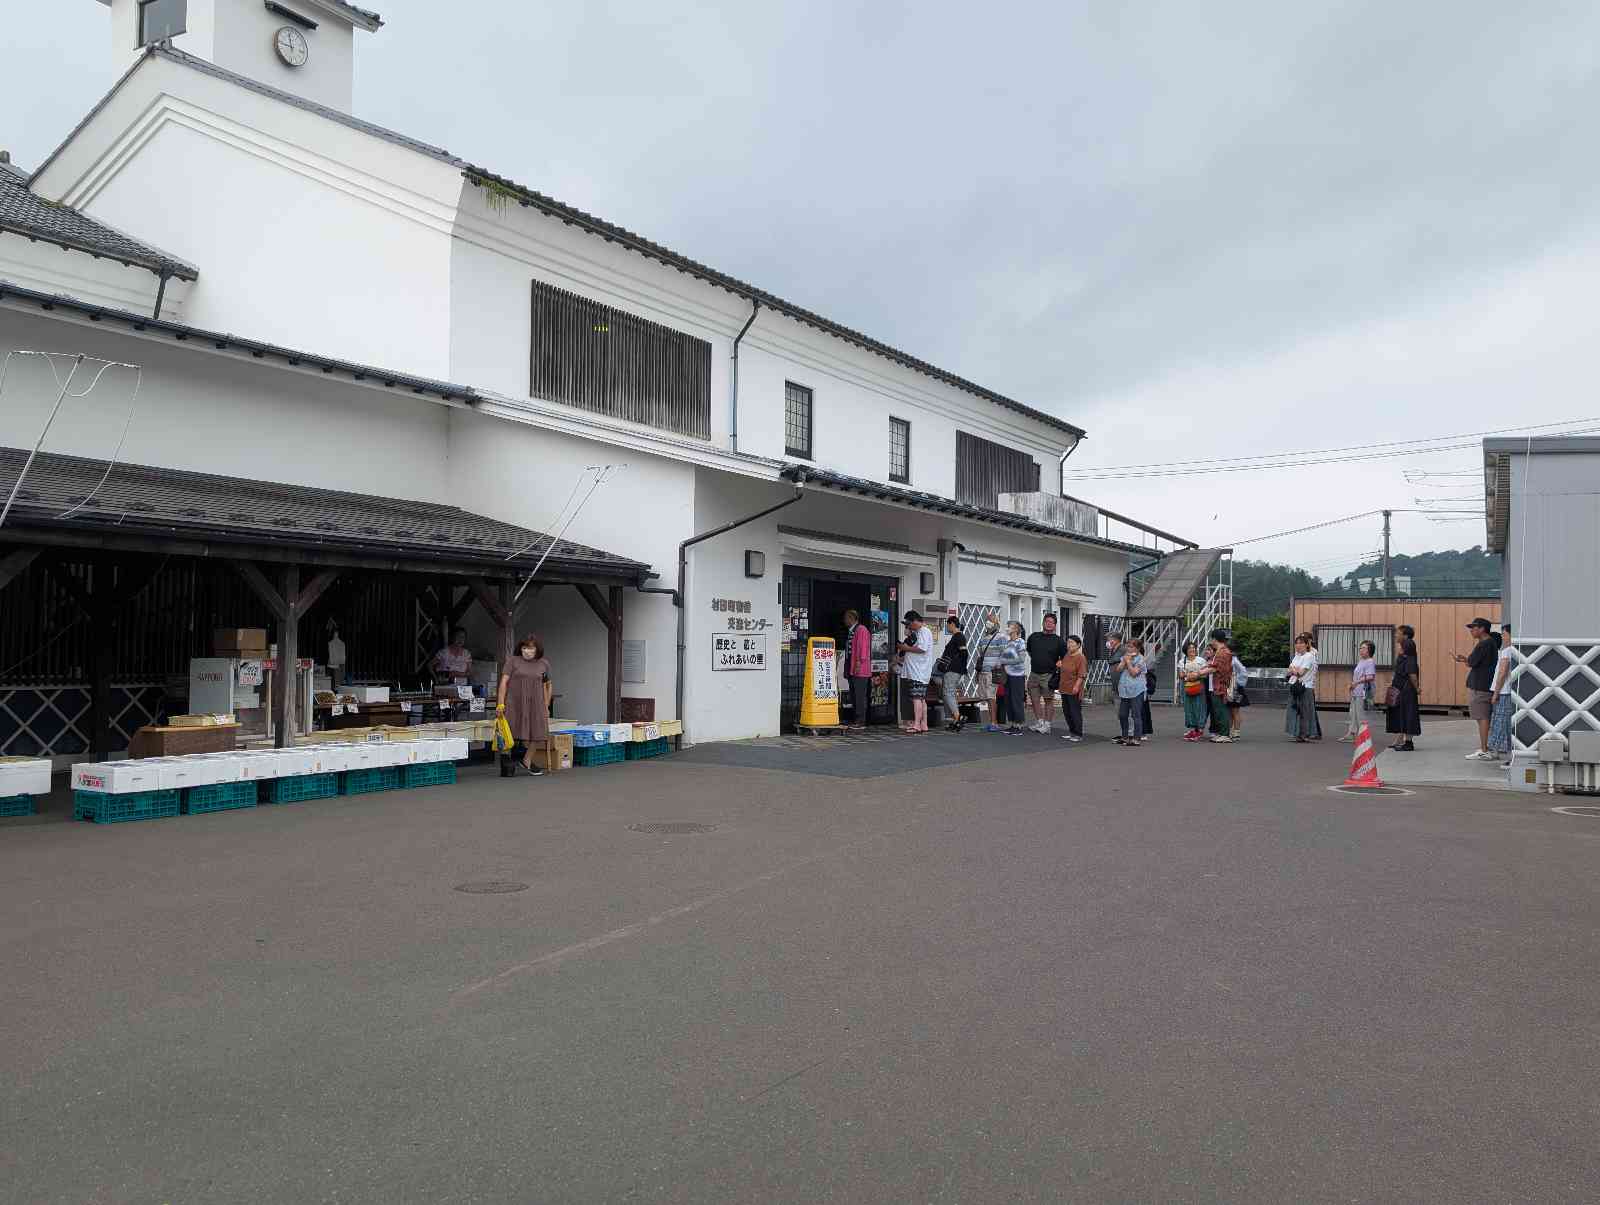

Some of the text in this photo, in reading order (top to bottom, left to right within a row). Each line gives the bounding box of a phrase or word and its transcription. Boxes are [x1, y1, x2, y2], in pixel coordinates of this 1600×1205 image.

[715, 638, 737, 650] 歴史と
[720, 653, 764, 665] ふれあいの里
